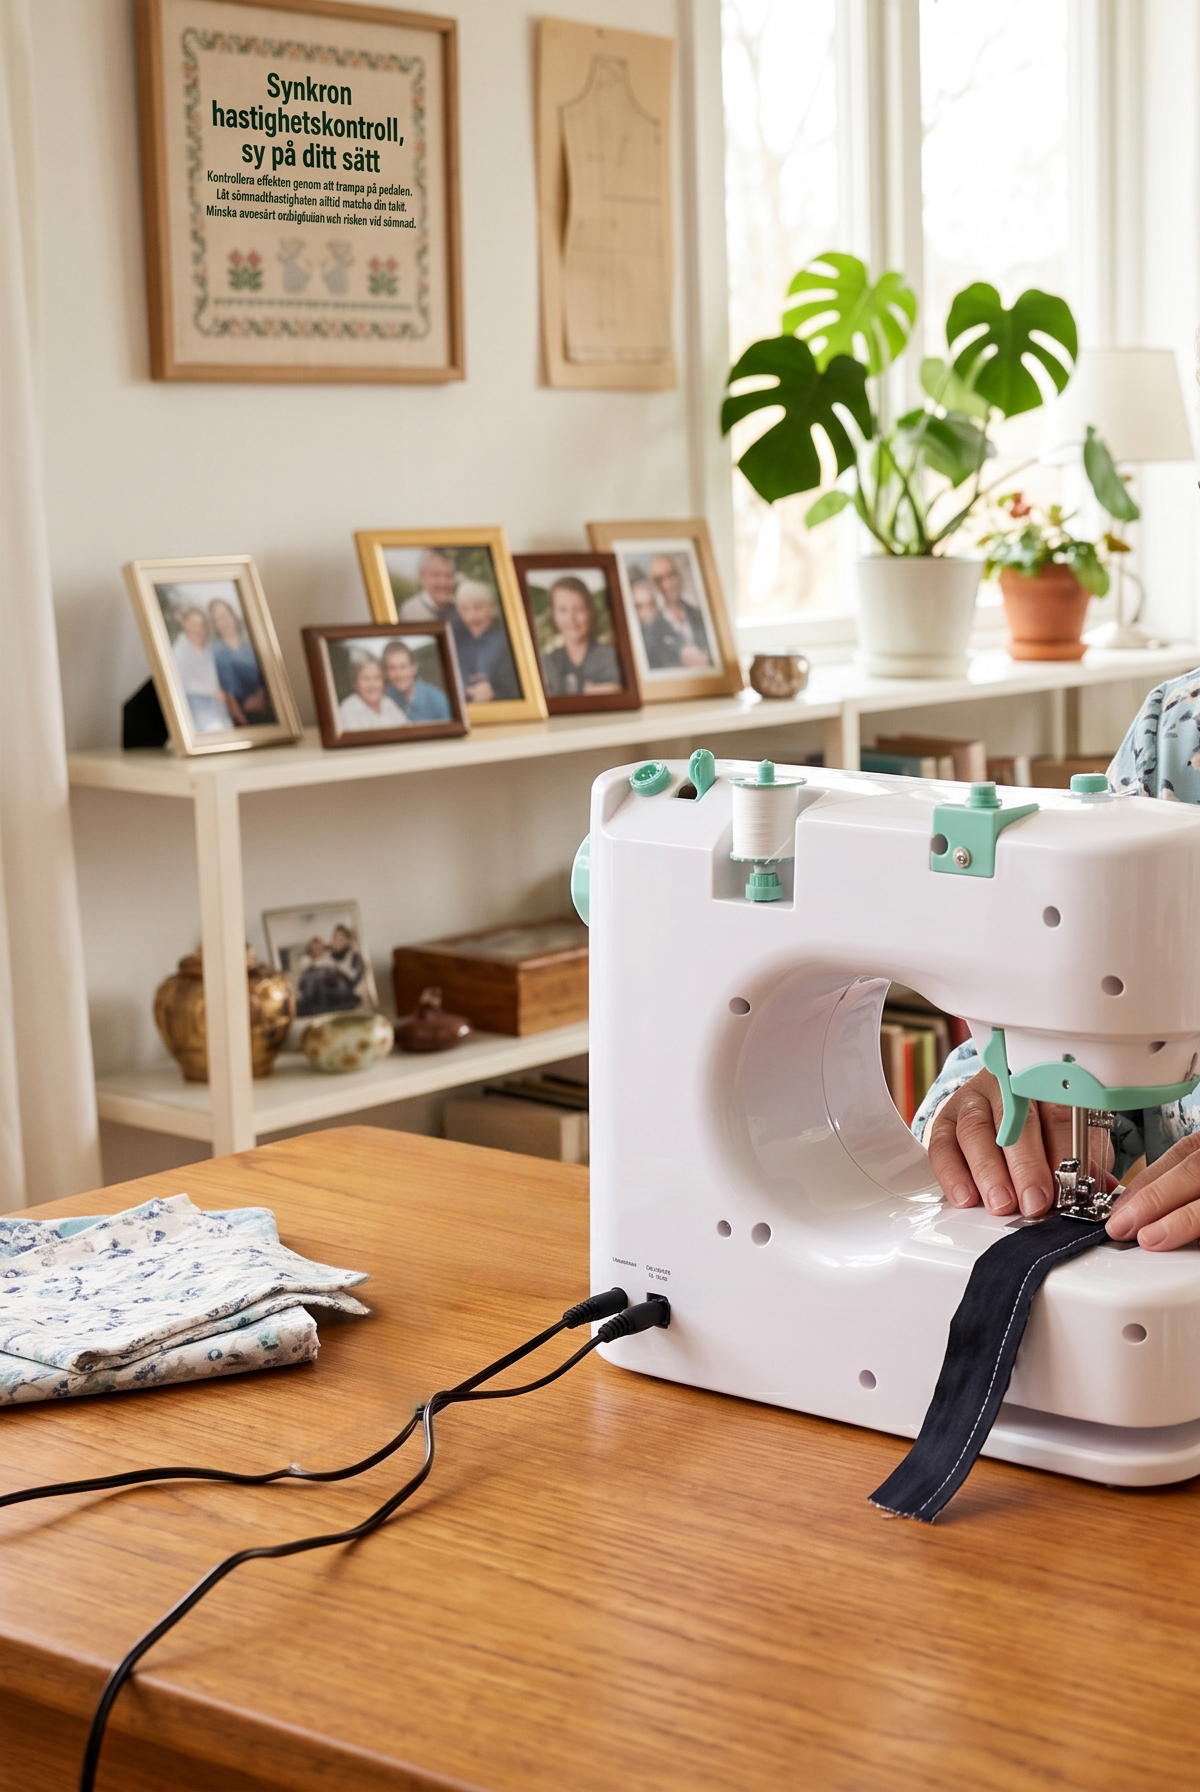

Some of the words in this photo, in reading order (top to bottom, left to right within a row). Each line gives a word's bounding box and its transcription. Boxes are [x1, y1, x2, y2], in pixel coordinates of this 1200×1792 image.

[267, 72, 352, 105] Synkron
[212, 99, 404, 146] hastighetskontroll,
[241, 143, 265, 170] sy
[272, 140, 296, 171] på
[302, 142, 337, 169] ditt
[342, 147, 380, 173] sätt
[207, 170, 254, 185] Kontrollera
[257, 174, 290, 187] effekten
[293, 180, 321, 191] genom
[323, 181, 334, 191] att
[336, 181, 364, 196] trampa
[366, 183, 377, 197] på
[379, 184, 412, 197] pedalen.
[206, 205, 237, 218] Minska
[343, 213, 367, 225] risken
[370, 215, 381, 226] vid
[374, 199, 386, 211] din
